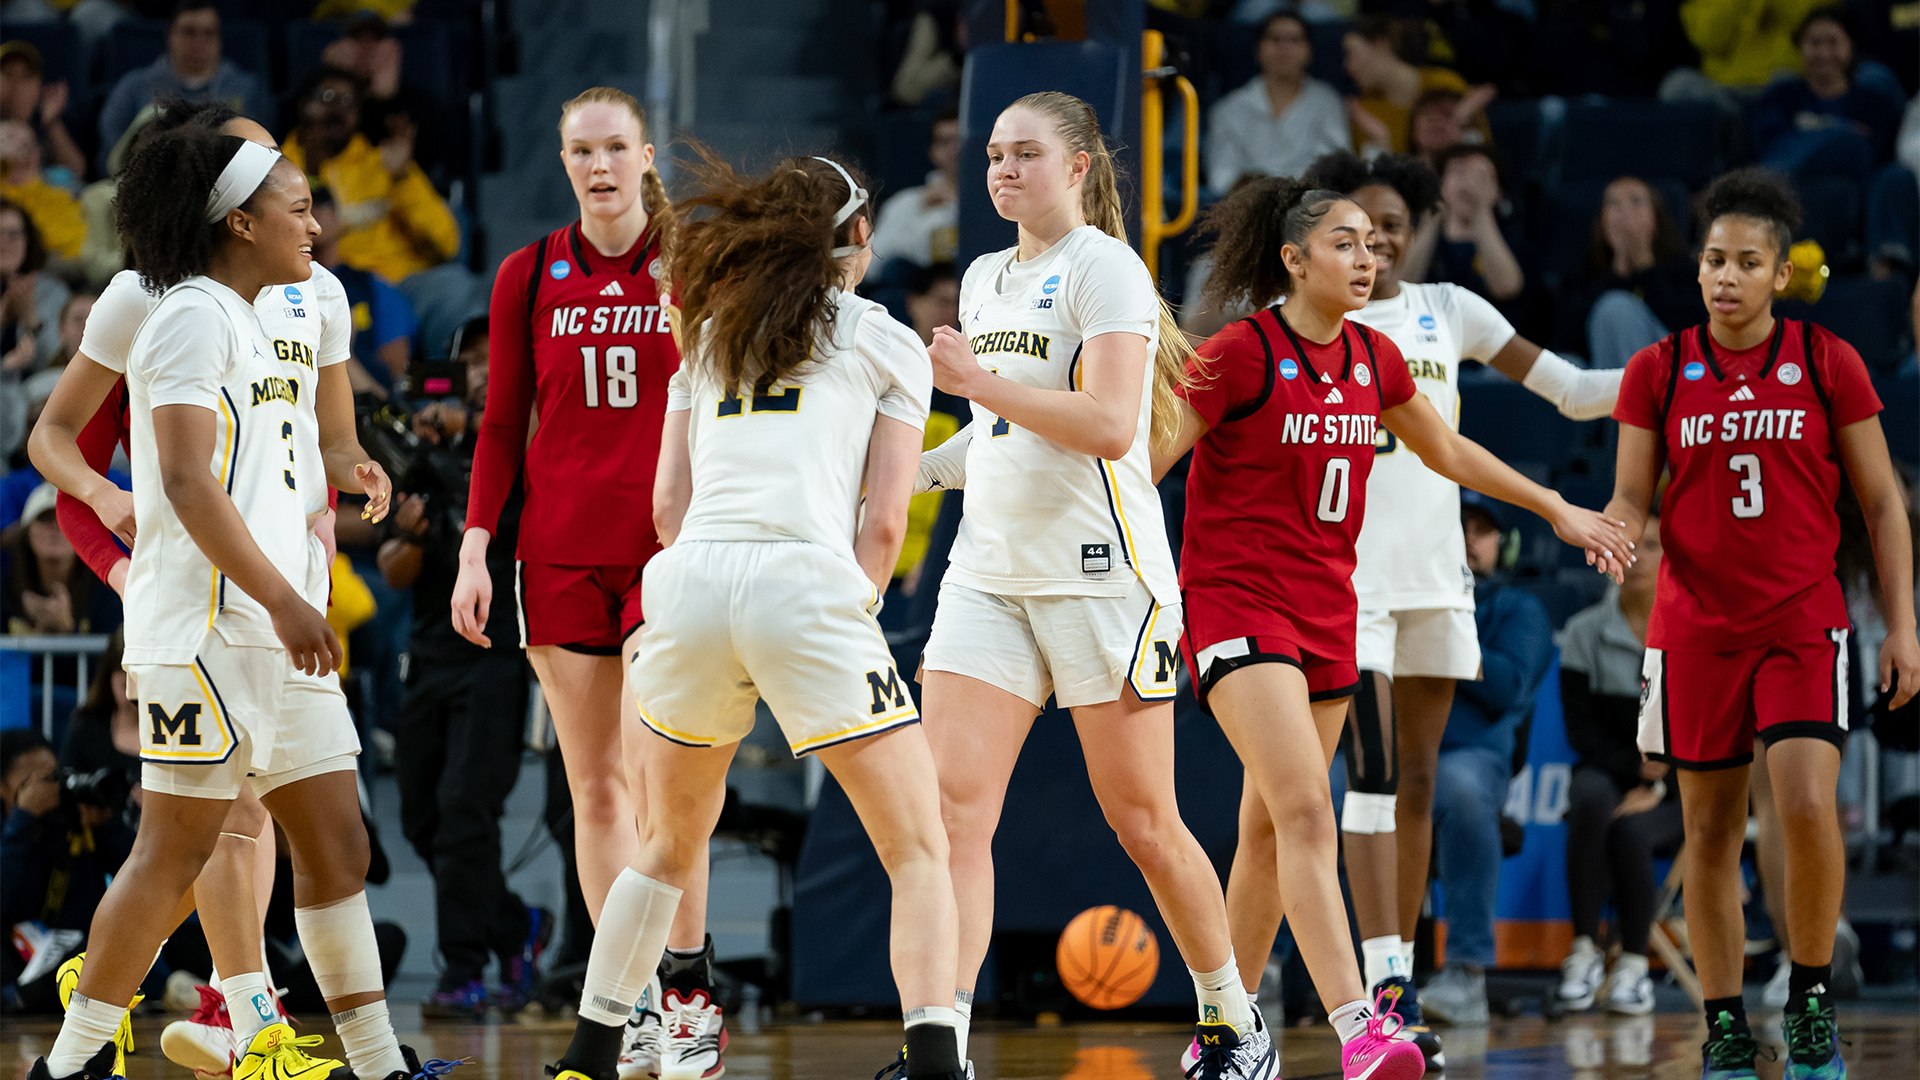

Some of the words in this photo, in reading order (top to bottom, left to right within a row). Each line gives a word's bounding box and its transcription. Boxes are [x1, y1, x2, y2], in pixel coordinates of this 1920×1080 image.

[551, 307, 587, 338] NC
[590, 305, 671, 334] STATE
[969, 330, 1051, 362] ICHIGAN
[579, 345, 639, 408] 18
[1280, 413, 1321, 444] NC
[1322, 414, 1377, 445] STATE
[1680, 413, 1715, 449] NC
[1720, 408, 1807, 443] STATE
[1316, 457, 1351, 523] 0
[1729, 453, 1765, 519] 3
[1087, 547, 1104, 556] 44
[1153, 639, 1178, 684] M
[865, 666, 906, 716] M
[147, 702, 204, 747] M
[1202, 1034, 1221, 1045] M
